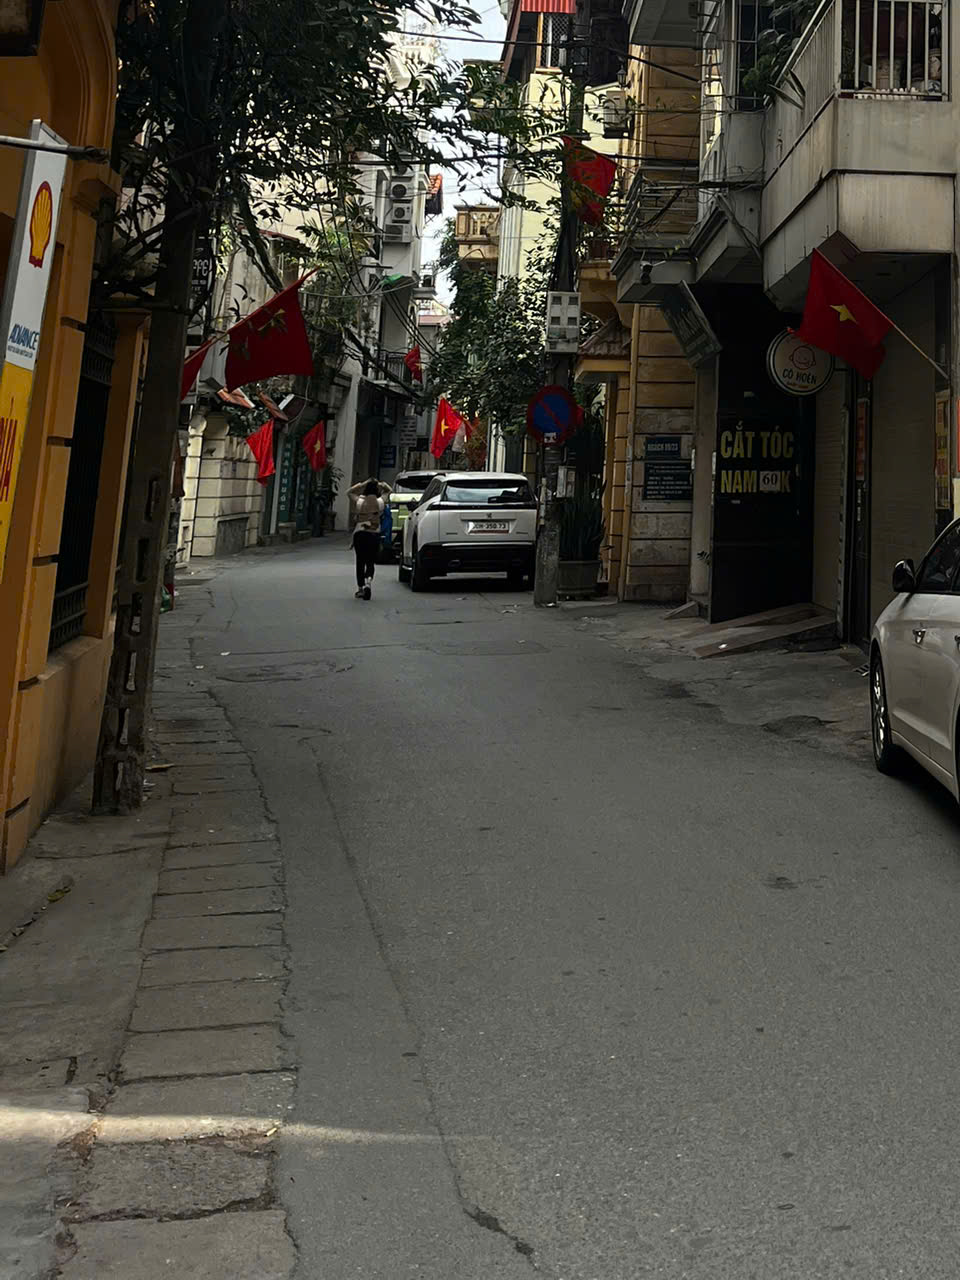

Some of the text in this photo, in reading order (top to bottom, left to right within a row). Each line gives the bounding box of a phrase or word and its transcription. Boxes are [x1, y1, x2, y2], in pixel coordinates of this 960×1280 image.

[8, 323, 40, 351] ADVANCE
[720, 420, 794, 459] CẮT TÓC
[720, 470, 758, 494] NAM
